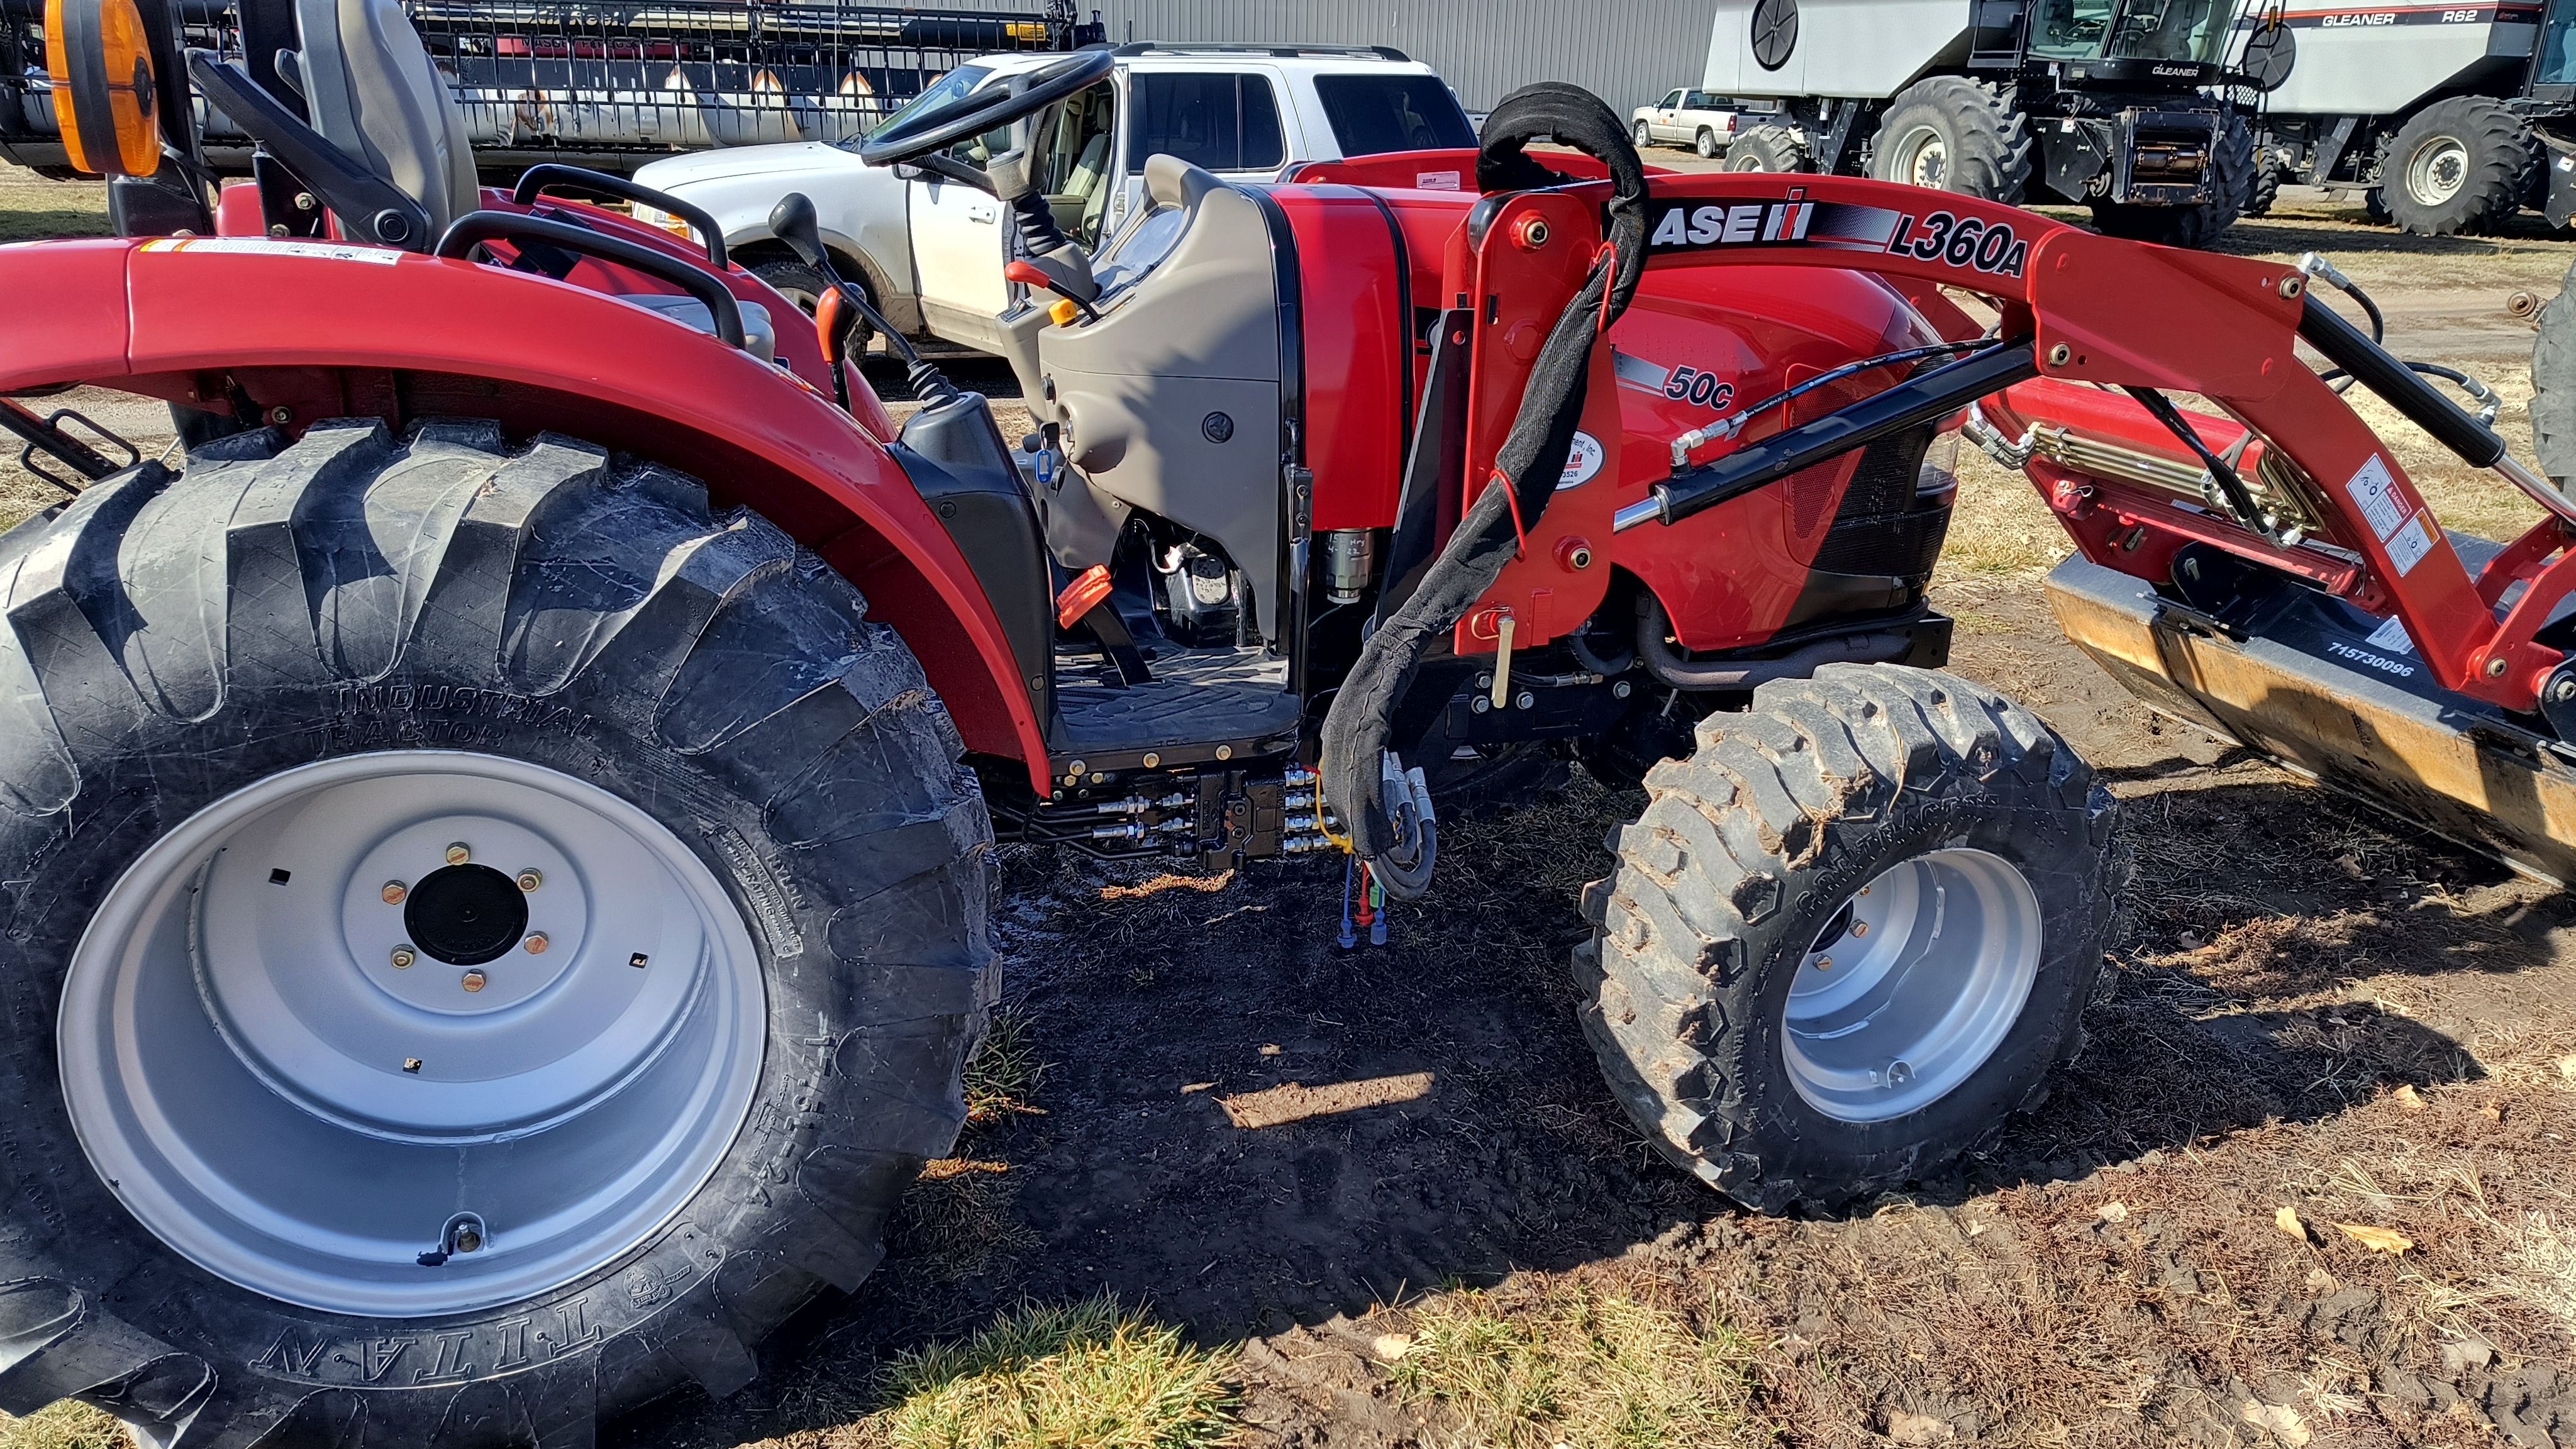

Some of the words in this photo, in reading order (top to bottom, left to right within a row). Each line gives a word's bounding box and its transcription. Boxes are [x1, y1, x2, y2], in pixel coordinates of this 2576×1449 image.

[2323, 13, 2396, 26] GLEANER
[2441, 10, 2477, 23] R62
[522, 39, 574, 47] MASSE
[2152, 64, 2199, 77] GLEANER
[1652, 204, 1763, 246] ASE
[1586, 443, 1596, 457] Inc.
[2390, 491, 2407, 514] DANGER
[2328, 641, 2414, 677] 715730096
[336, 685, 596, 740] INDUSTRIAL
[305, 719, 508, 755] TRACTOR
[765, 852, 807, 909] NYLON
[247, 1295, 604, 1385] TITAN
